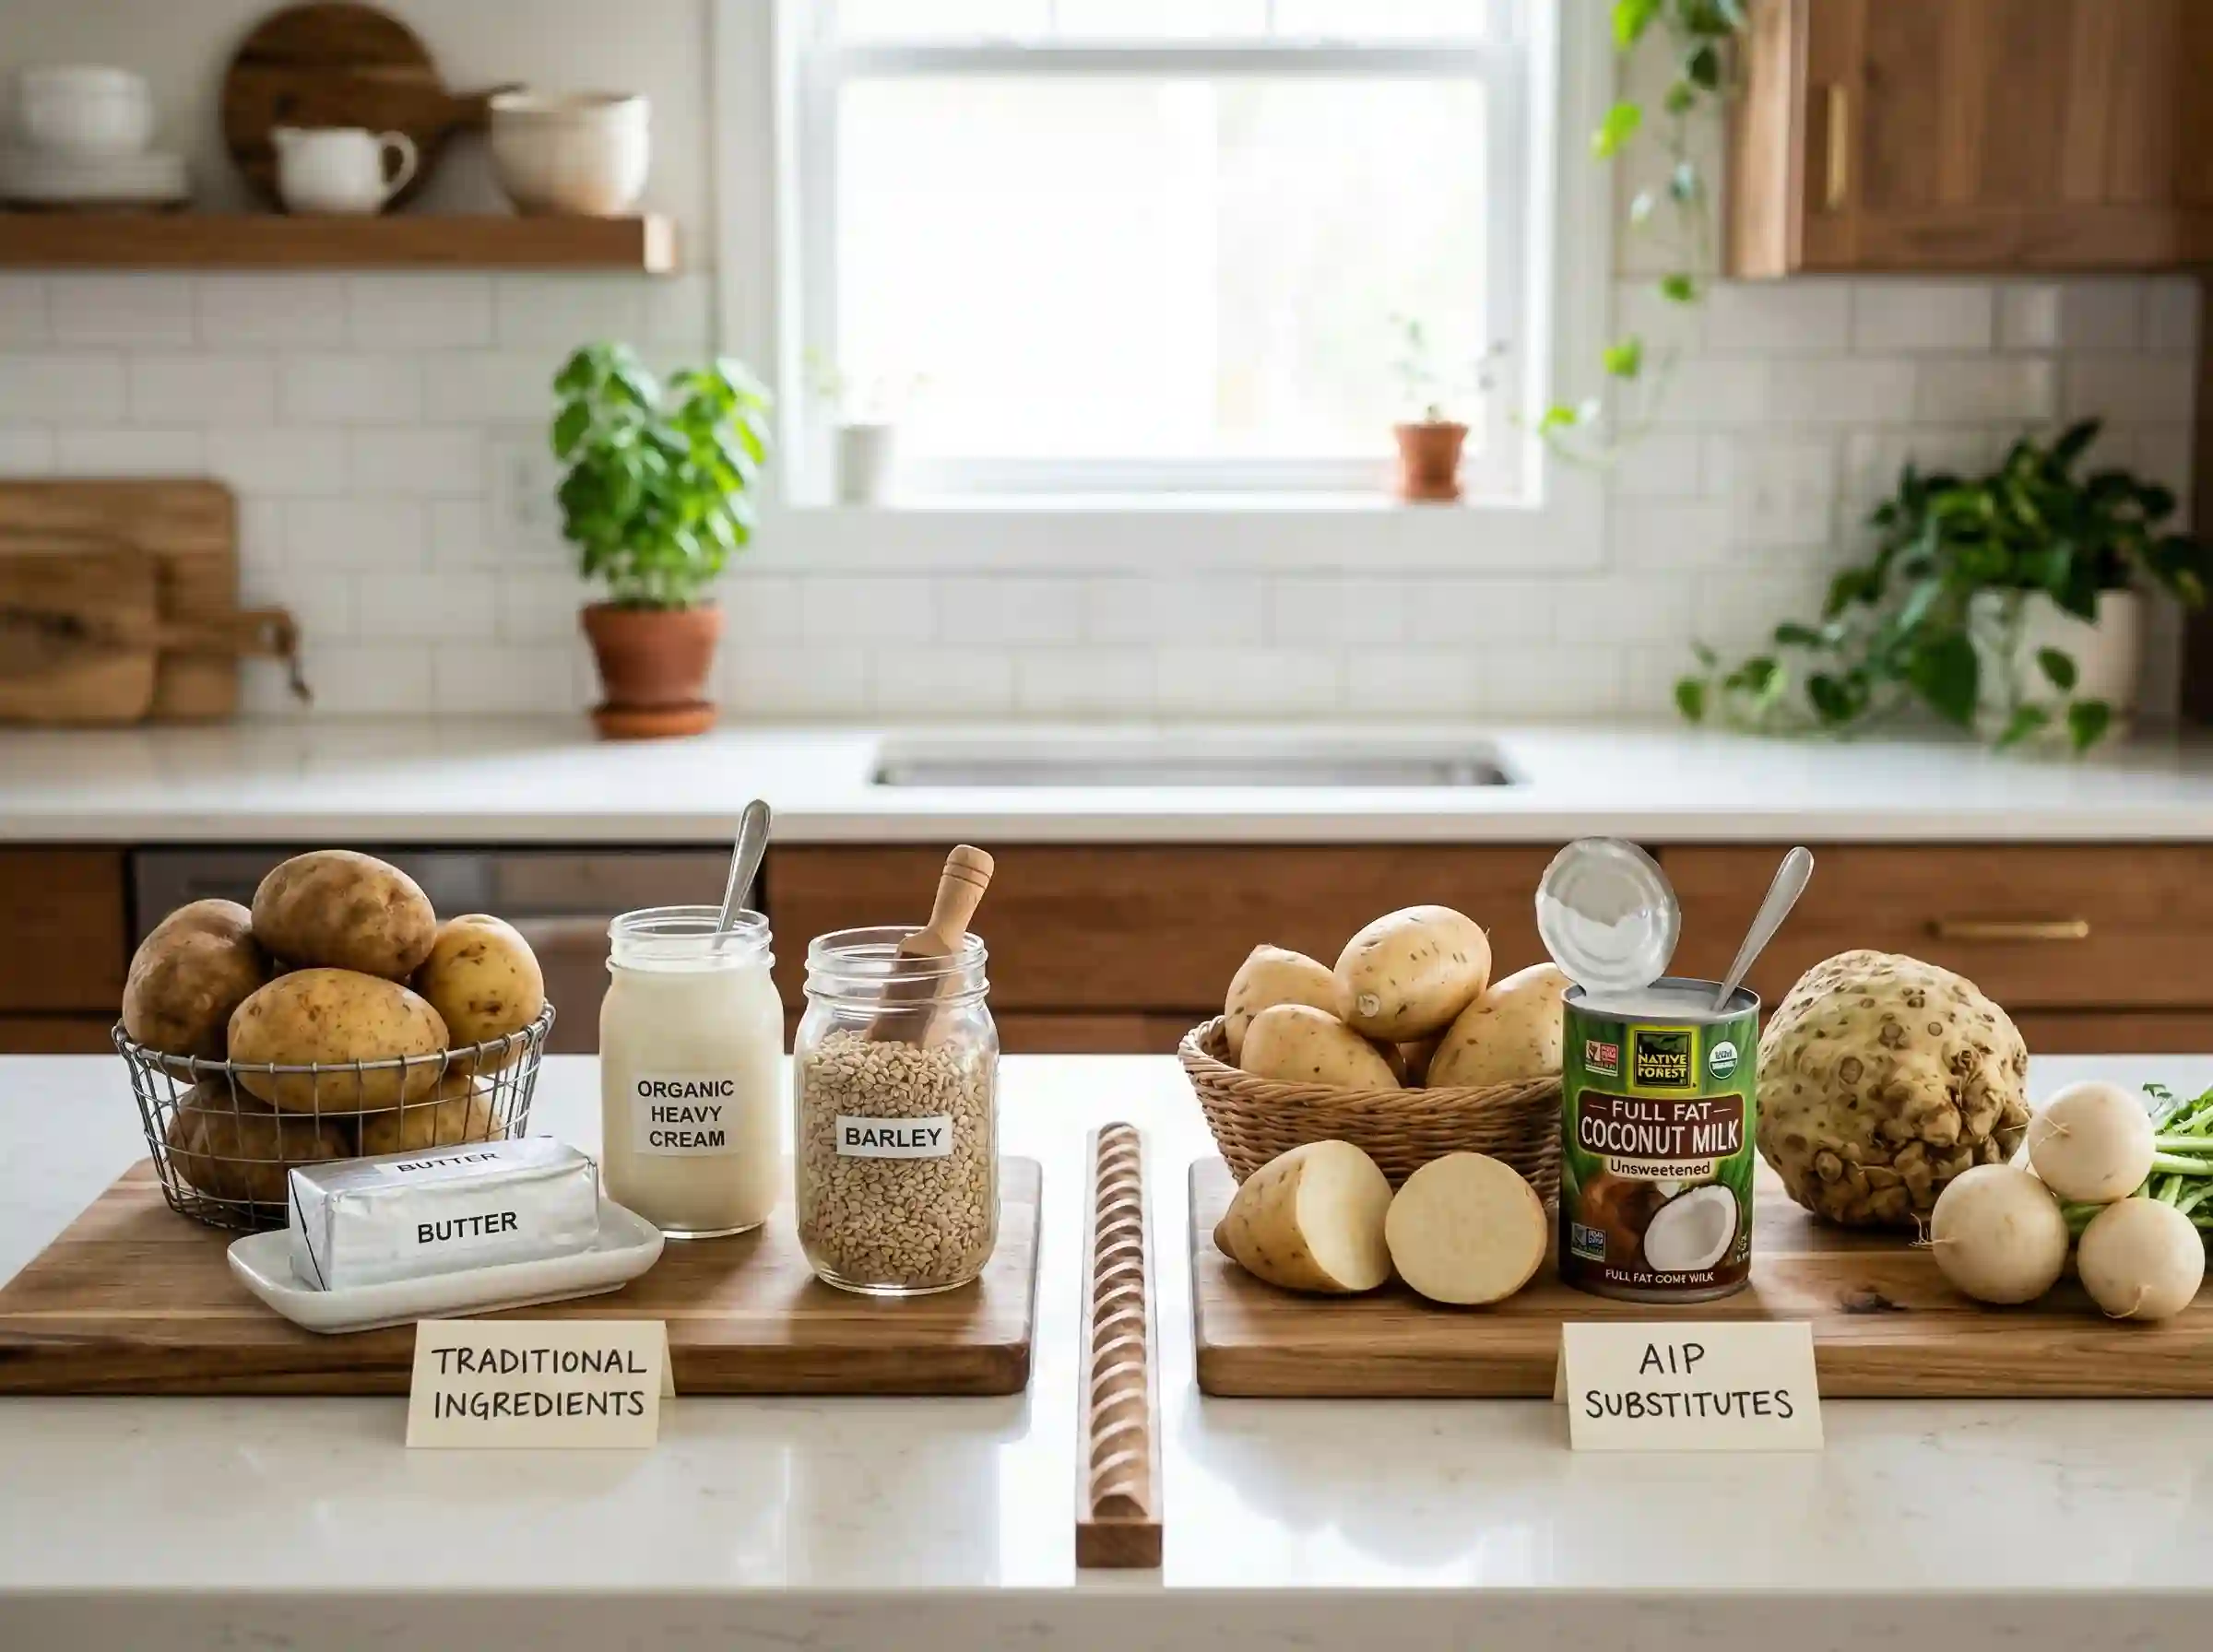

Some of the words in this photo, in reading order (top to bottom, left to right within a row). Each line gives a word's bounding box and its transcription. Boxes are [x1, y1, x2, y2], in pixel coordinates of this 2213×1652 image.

[1638, 1053, 1686, 1064] NATIVE
[1638, 1065, 1686, 1078] FOREST
[636, 1079, 735, 1099] ORGANIC
[650, 1105, 723, 1124] HEAVY
[1612, 1100, 1665, 1121] FULL
[1674, 1103, 1711, 1121] FAT
[648, 1128, 726, 1149] CREAM
[845, 1126, 943, 1149] BARLEY
[1580, 1115, 1686, 1155] COCONUT
[1692, 1117, 1739, 1153] MILK
[396, 1152, 502, 1172] BUTTER
[1610, 1159, 1710, 1176] Unsweetened
[418, 1211, 518, 1244] BUTTER
[1605, 1268, 1630, 1281] FULL
[1633, 1272, 1652, 1283] FAT
[431, 1346, 647, 1375] TRADITIONAL
[1639, 1342, 1705, 1375] AIP
[433, 1390, 645, 1420] INGREDIENTS
[1585, 1389, 1793, 1419] SUBSTITUTES
